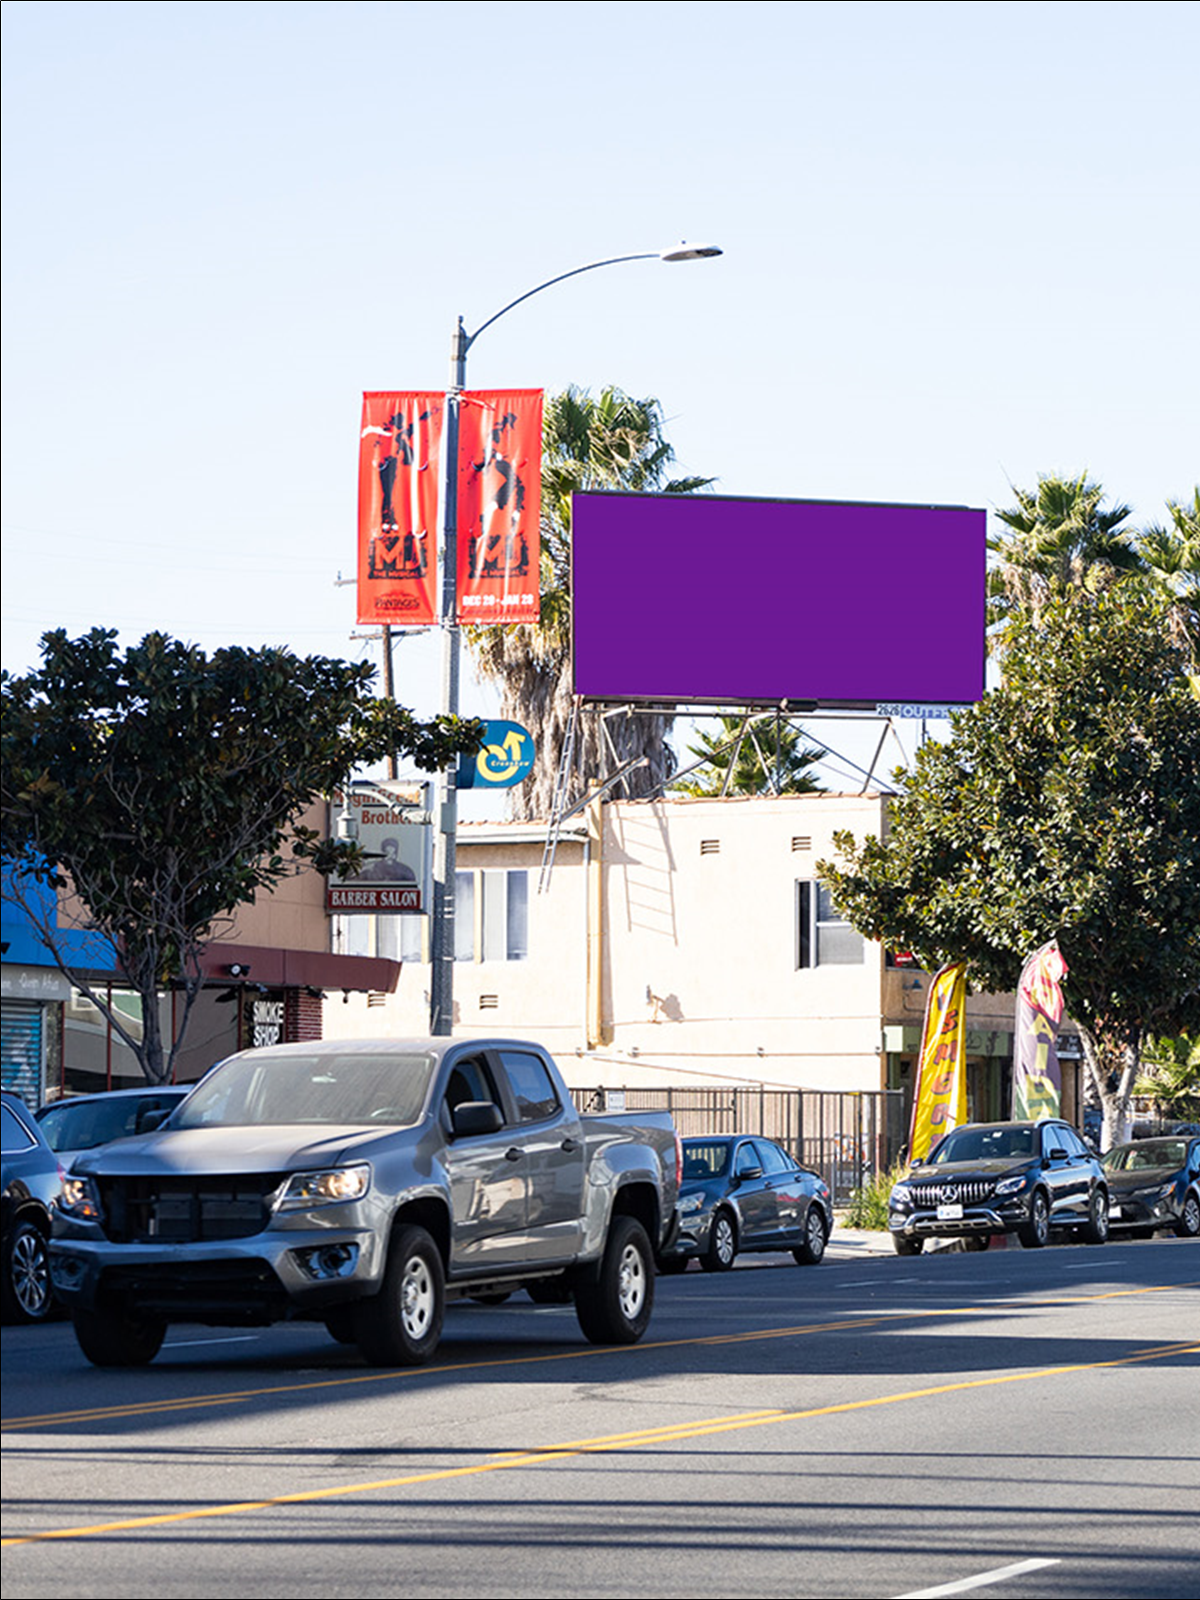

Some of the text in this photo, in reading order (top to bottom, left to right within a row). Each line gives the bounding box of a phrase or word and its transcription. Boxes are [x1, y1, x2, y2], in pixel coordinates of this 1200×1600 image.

[374, 536, 422, 570] MJ
[476, 535, 522, 569] MJ
[332, 892, 418, 906] BARBER SALON
[253, 1001, 284, 1023] SMOKE
[253, 1026, 280, 1047] SHOP
